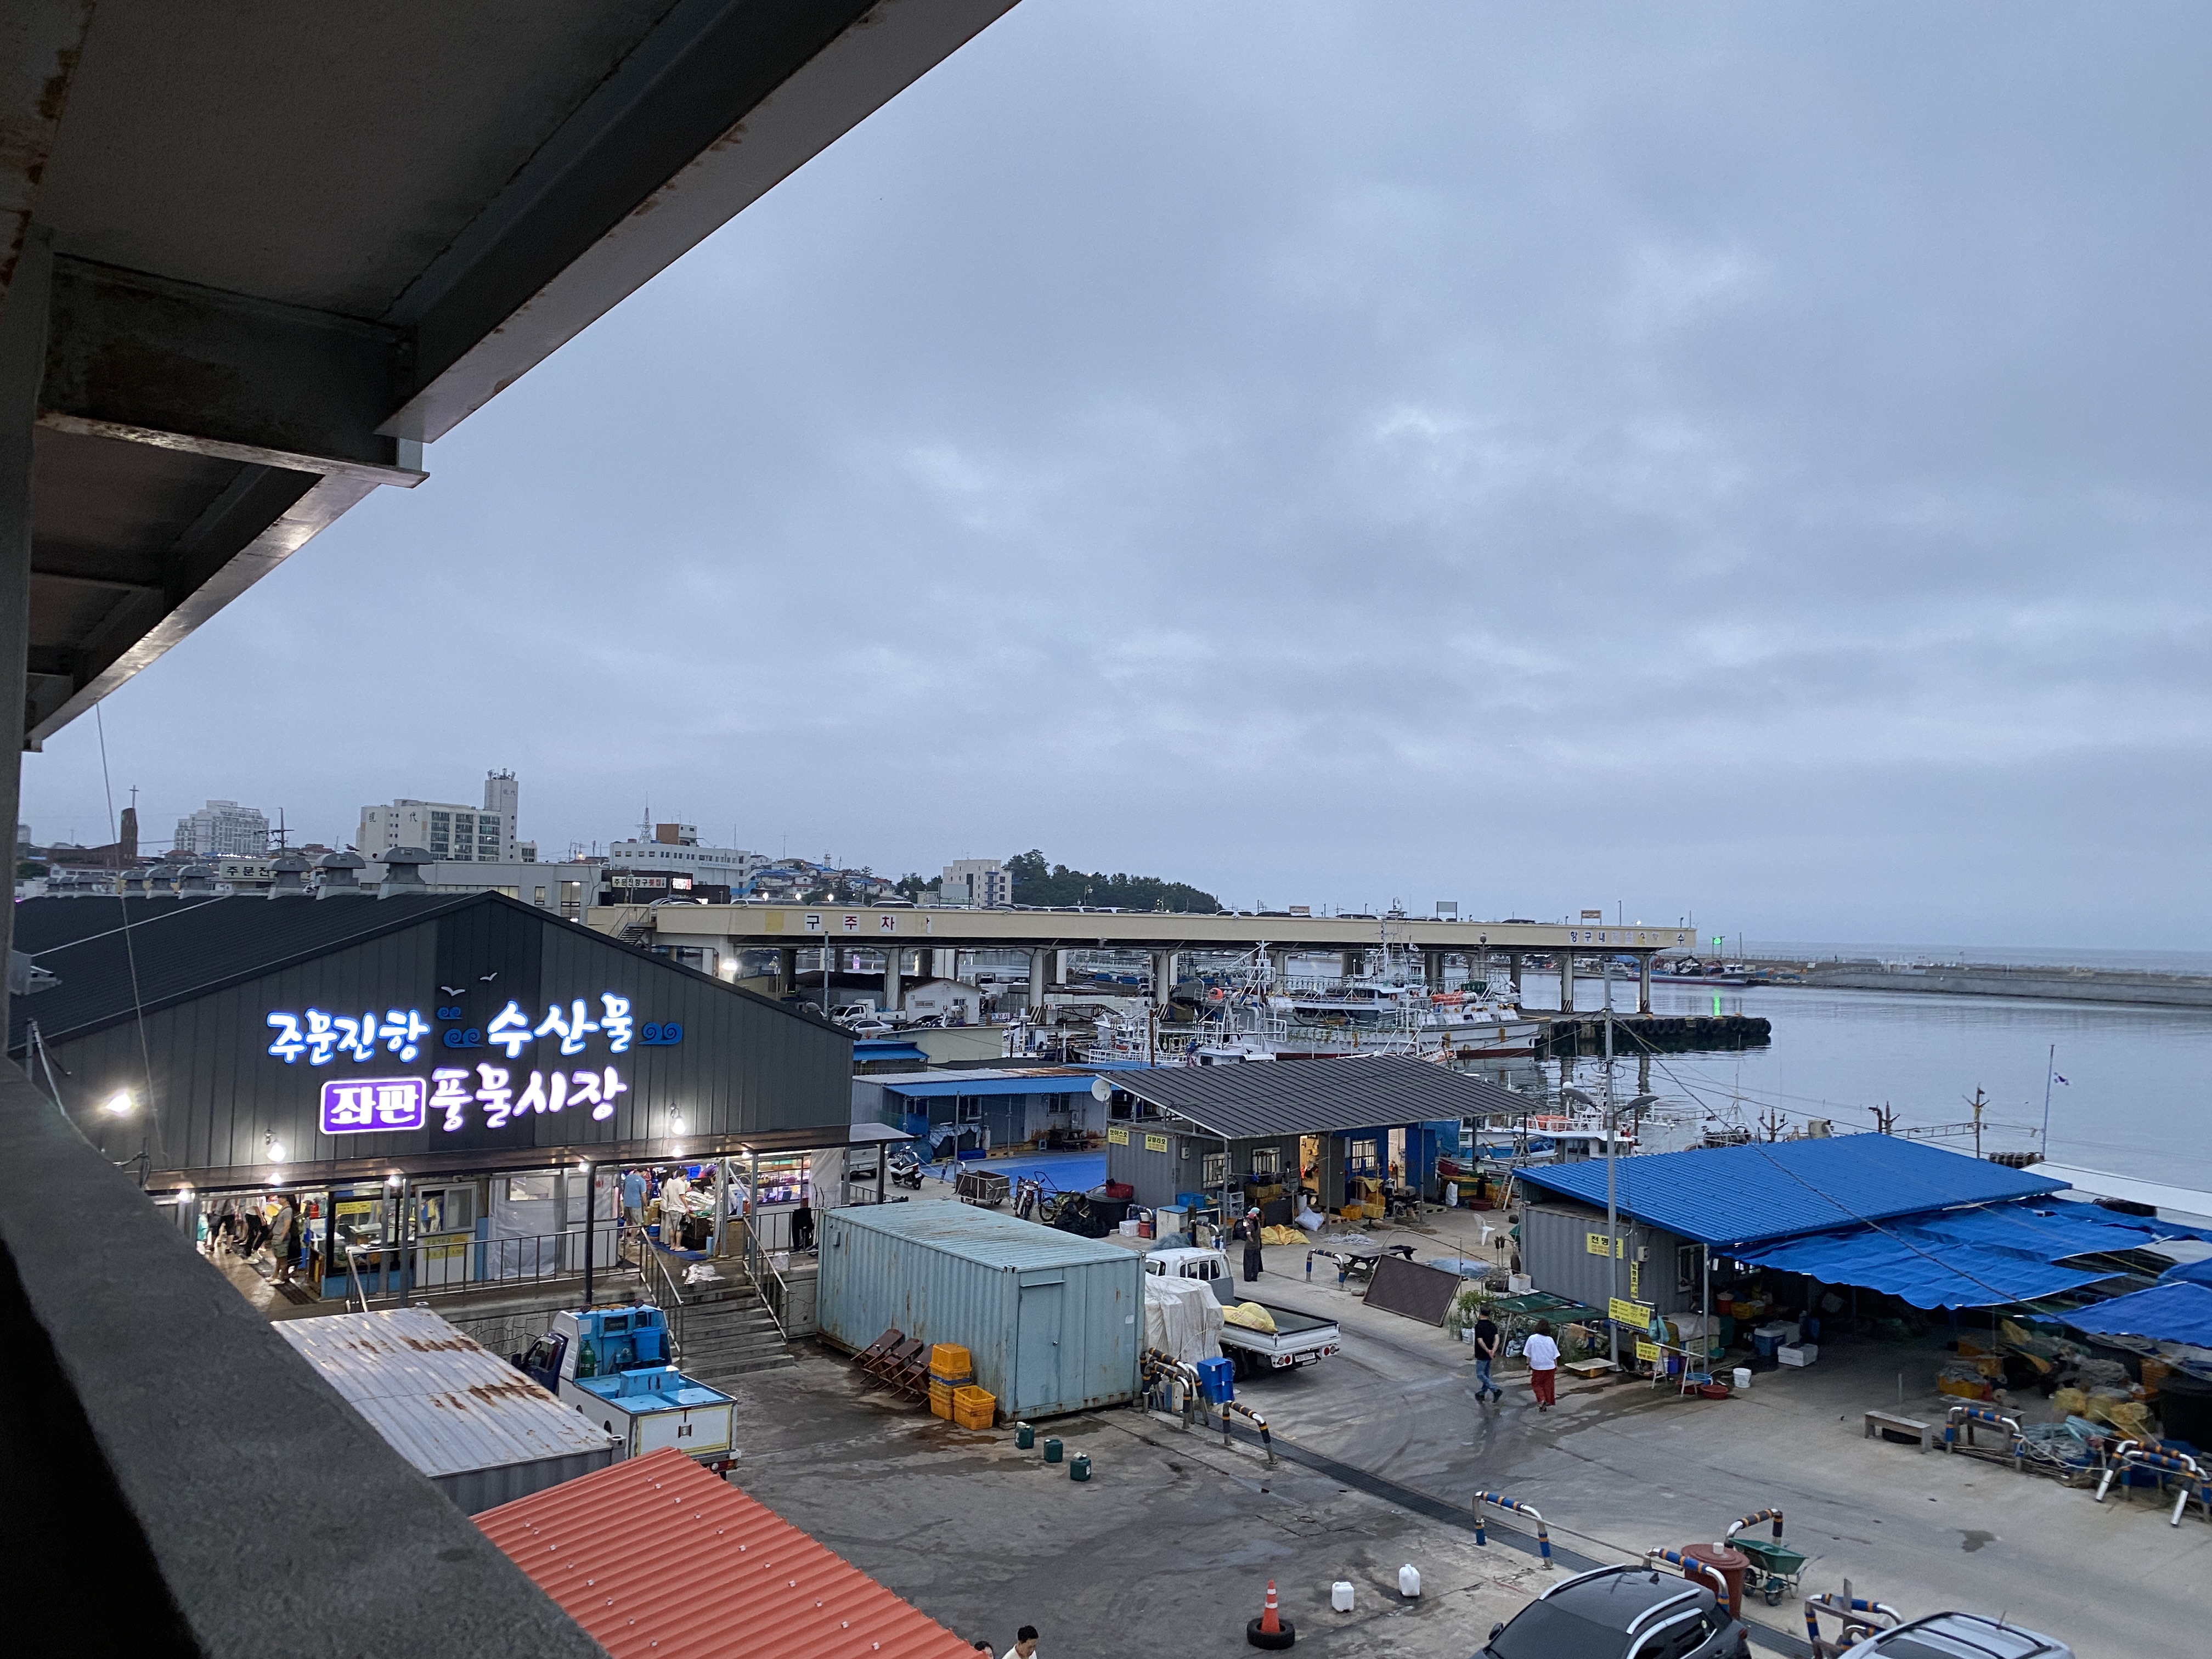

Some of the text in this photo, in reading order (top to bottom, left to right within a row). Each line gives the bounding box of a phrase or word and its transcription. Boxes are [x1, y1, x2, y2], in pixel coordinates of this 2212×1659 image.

[227, 866, 278, 877] 주문진
[267, 991, 633, 1065] 주문진항 수산물
[330, 1063, 628, 1132] 좌판 풍물시장
